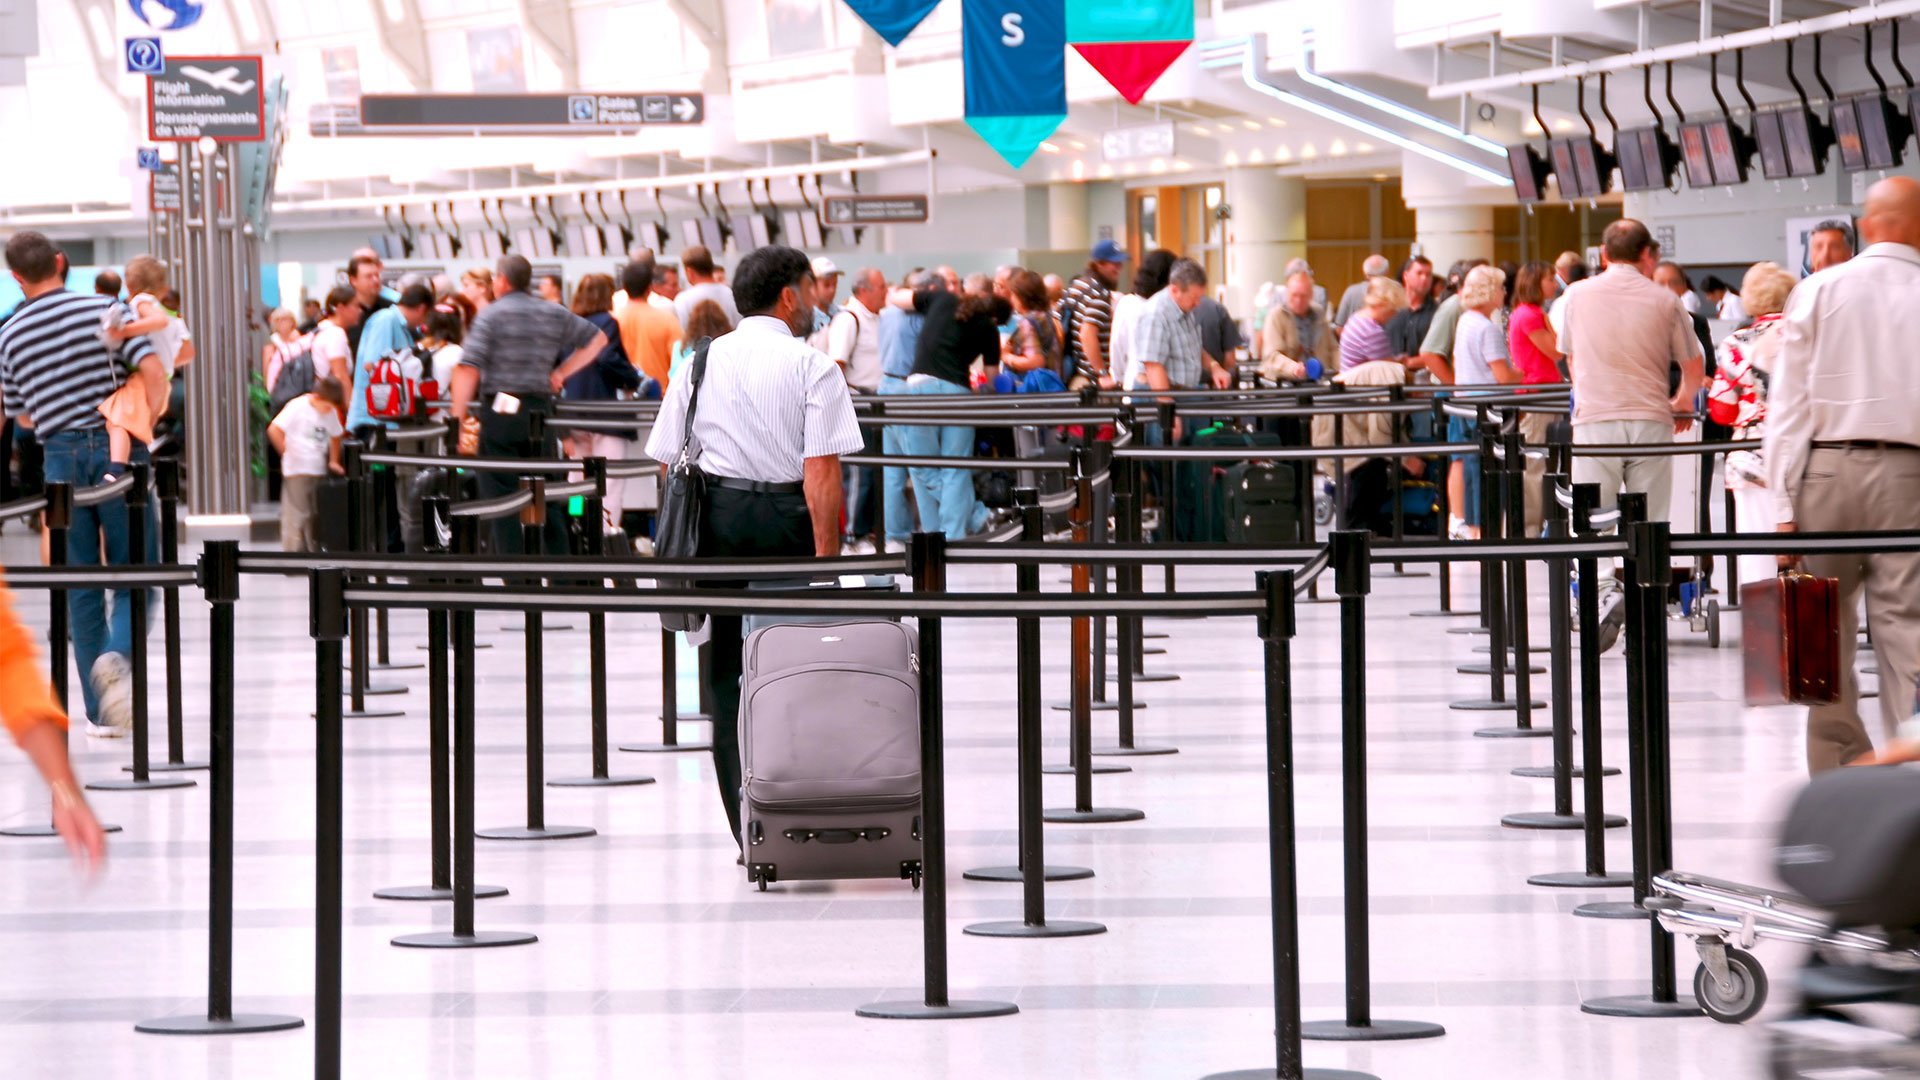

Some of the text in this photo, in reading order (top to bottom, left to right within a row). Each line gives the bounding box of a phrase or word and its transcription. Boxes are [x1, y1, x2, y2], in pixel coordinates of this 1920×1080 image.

[1001, 12, 1025, 47] S
[154, 81, 191, 96] Flight
[154, 93, 226, 106] Information
[598, 96, 637, 108] Gates
[155, 110, 258, 127] Renseignements
[598, 110, 642, 122] Portes
[155, 124, 200, 137] de vols
